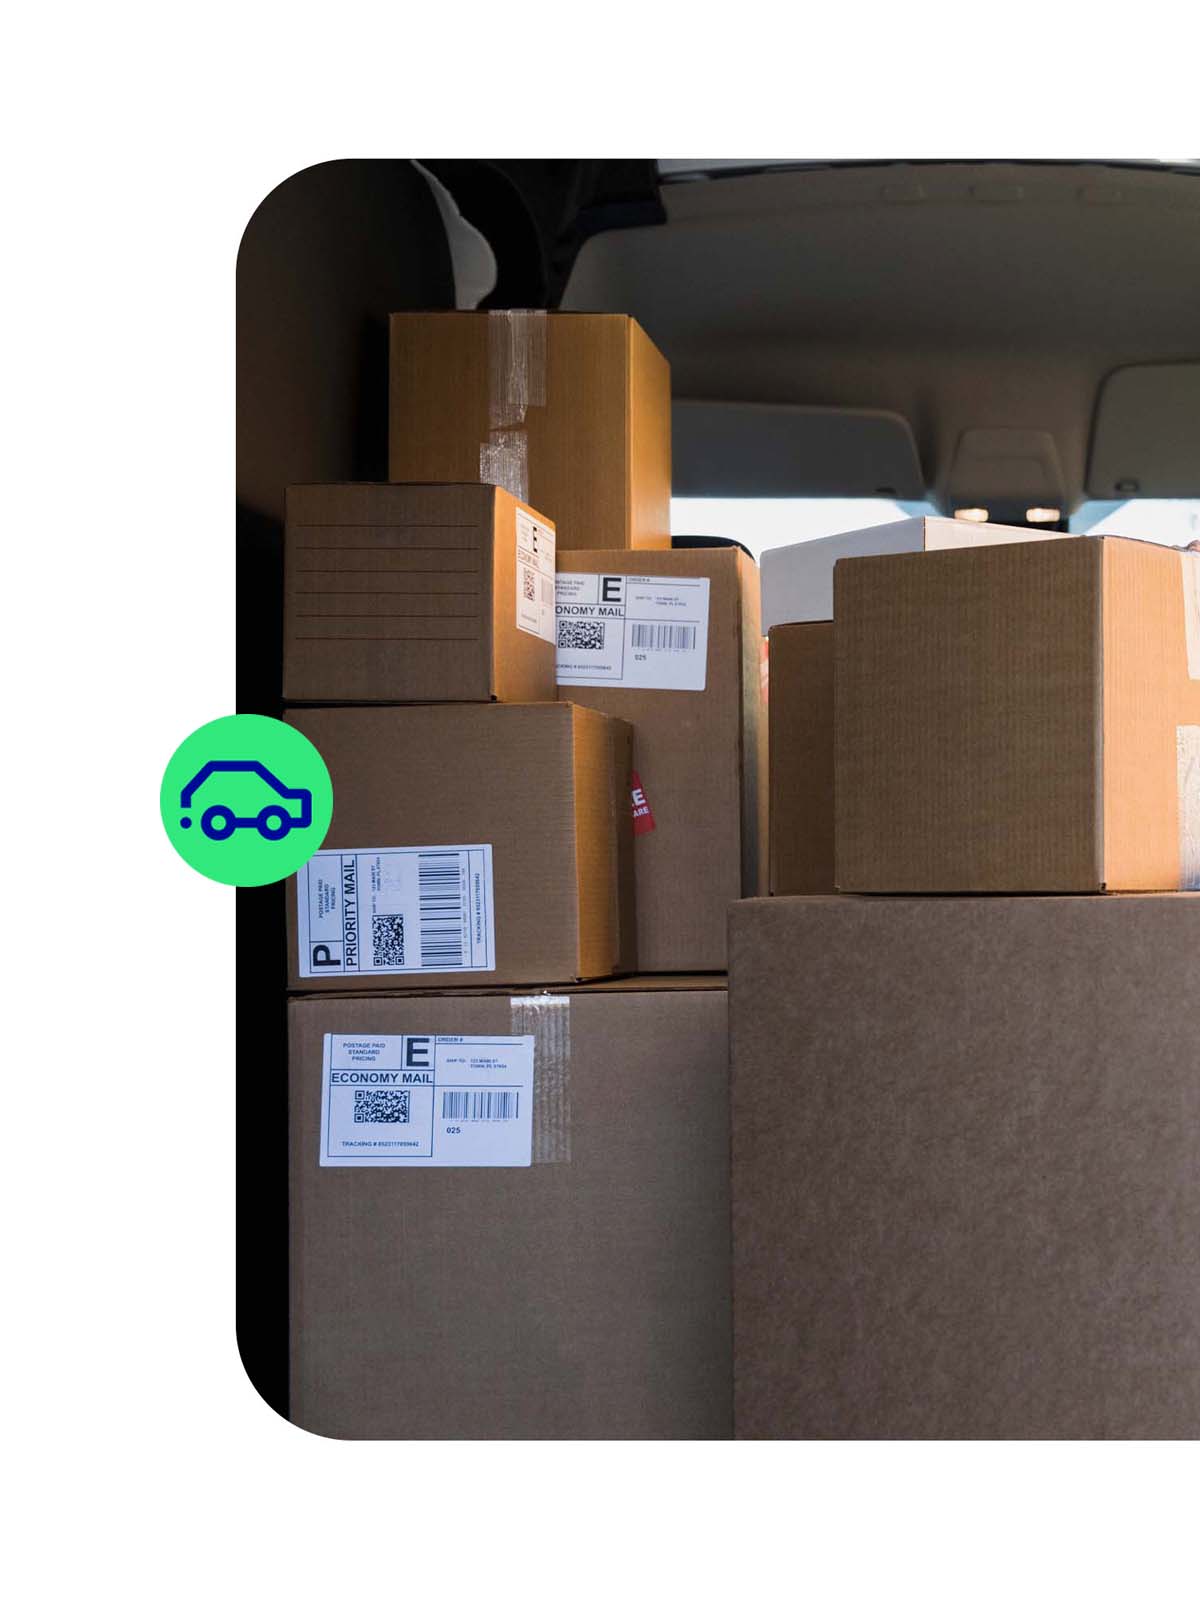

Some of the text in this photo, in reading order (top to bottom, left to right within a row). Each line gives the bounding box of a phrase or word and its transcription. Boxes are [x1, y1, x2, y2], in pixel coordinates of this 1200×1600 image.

[532, 526, 538, 553] E
[602, 577, 622, 602] E
[555, 606, 596, 616] ONOMY
[598, 607, 624, 617] MAIL
[344, 860, 357, 966] PRIORITY MAIL
[313, 945, 341, 966] P
[406, 1038, 429, 1066] E
[331, 1073, 433, 1084] ECONOMY MAIL
